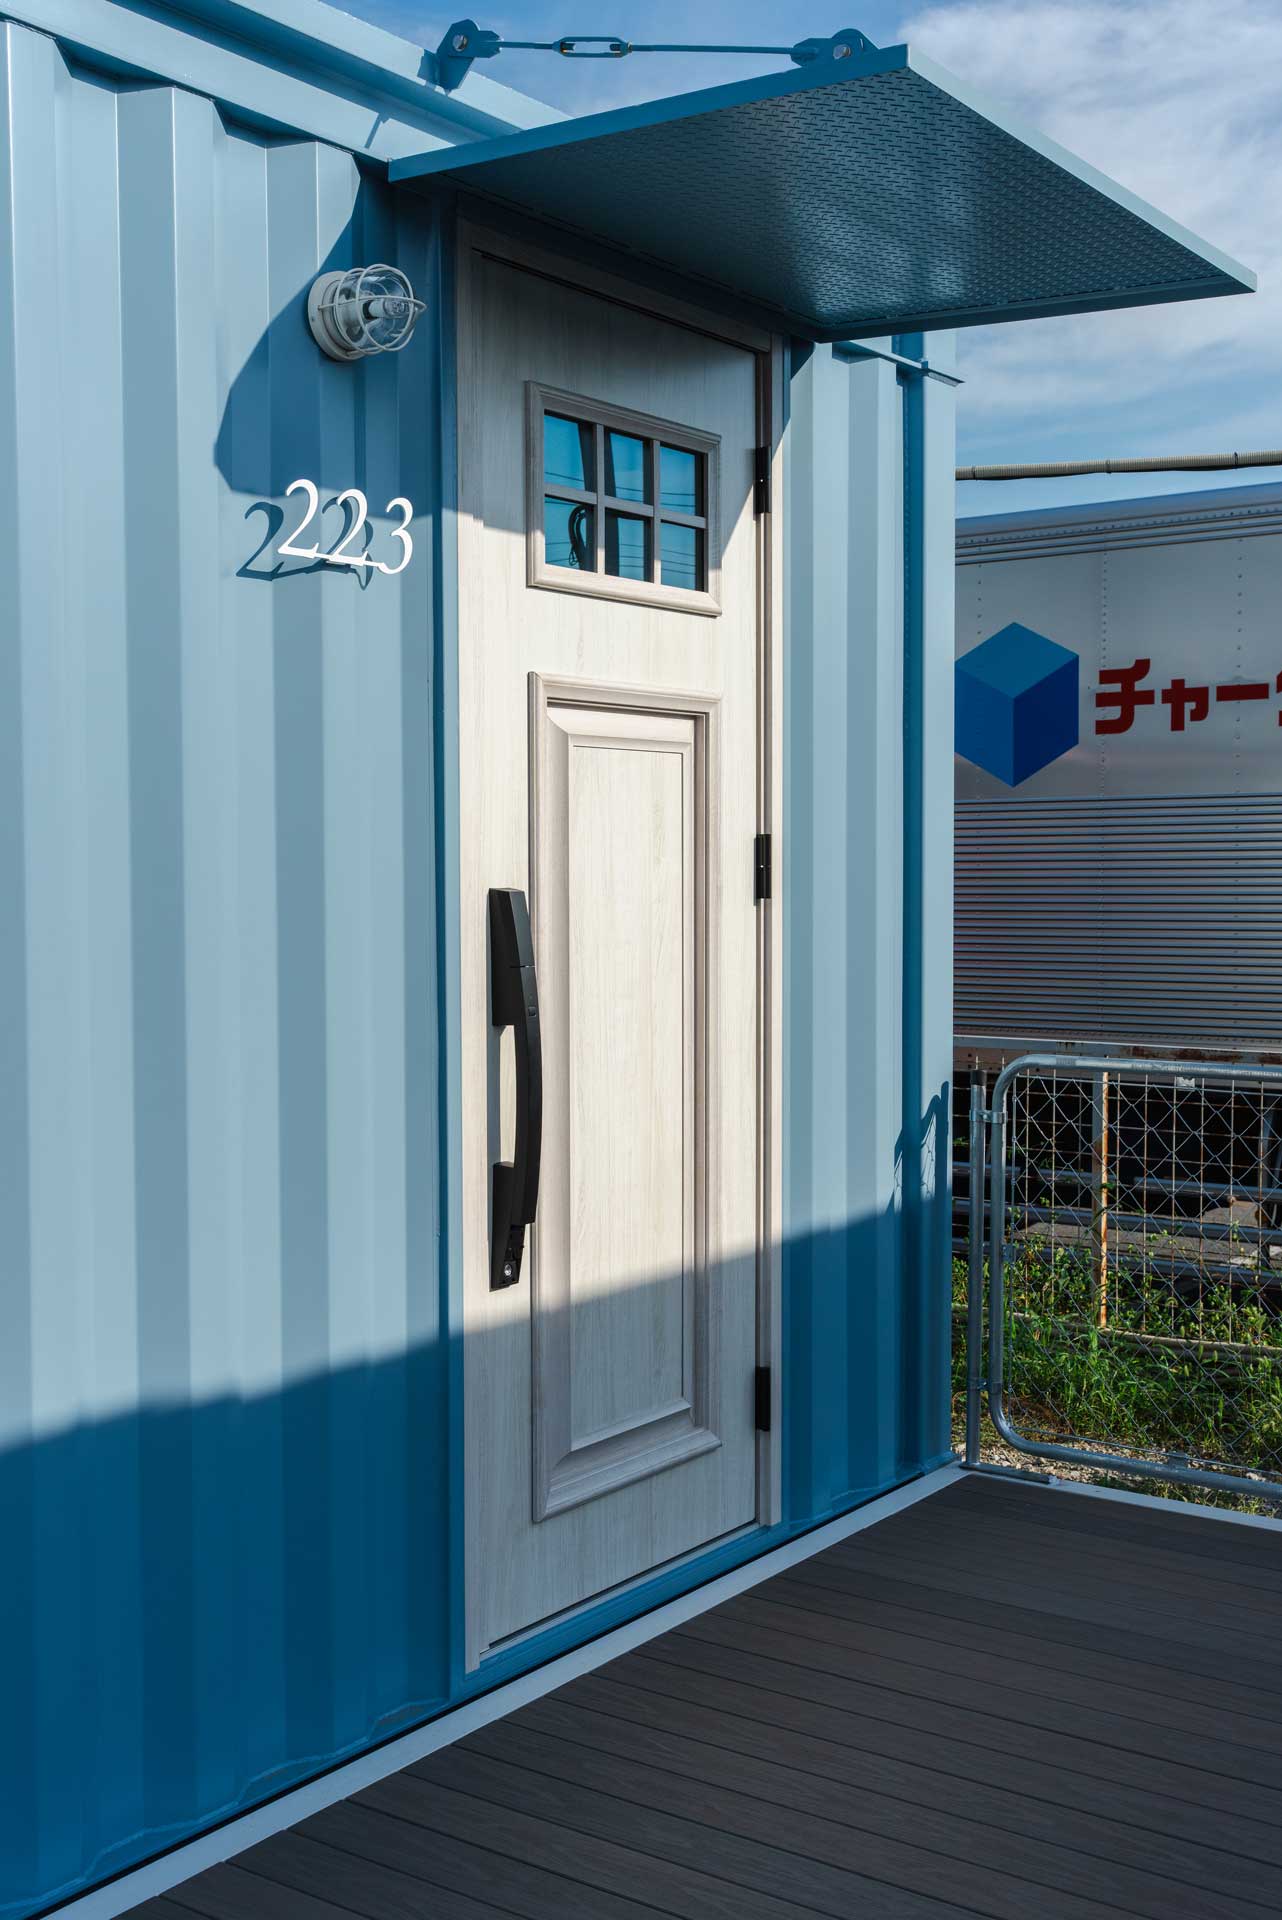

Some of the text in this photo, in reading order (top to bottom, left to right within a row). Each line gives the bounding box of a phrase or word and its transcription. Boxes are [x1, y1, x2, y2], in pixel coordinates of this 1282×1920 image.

[277, 478, 414, 575] 223
[1095, 658, 1282, 735] チャー
